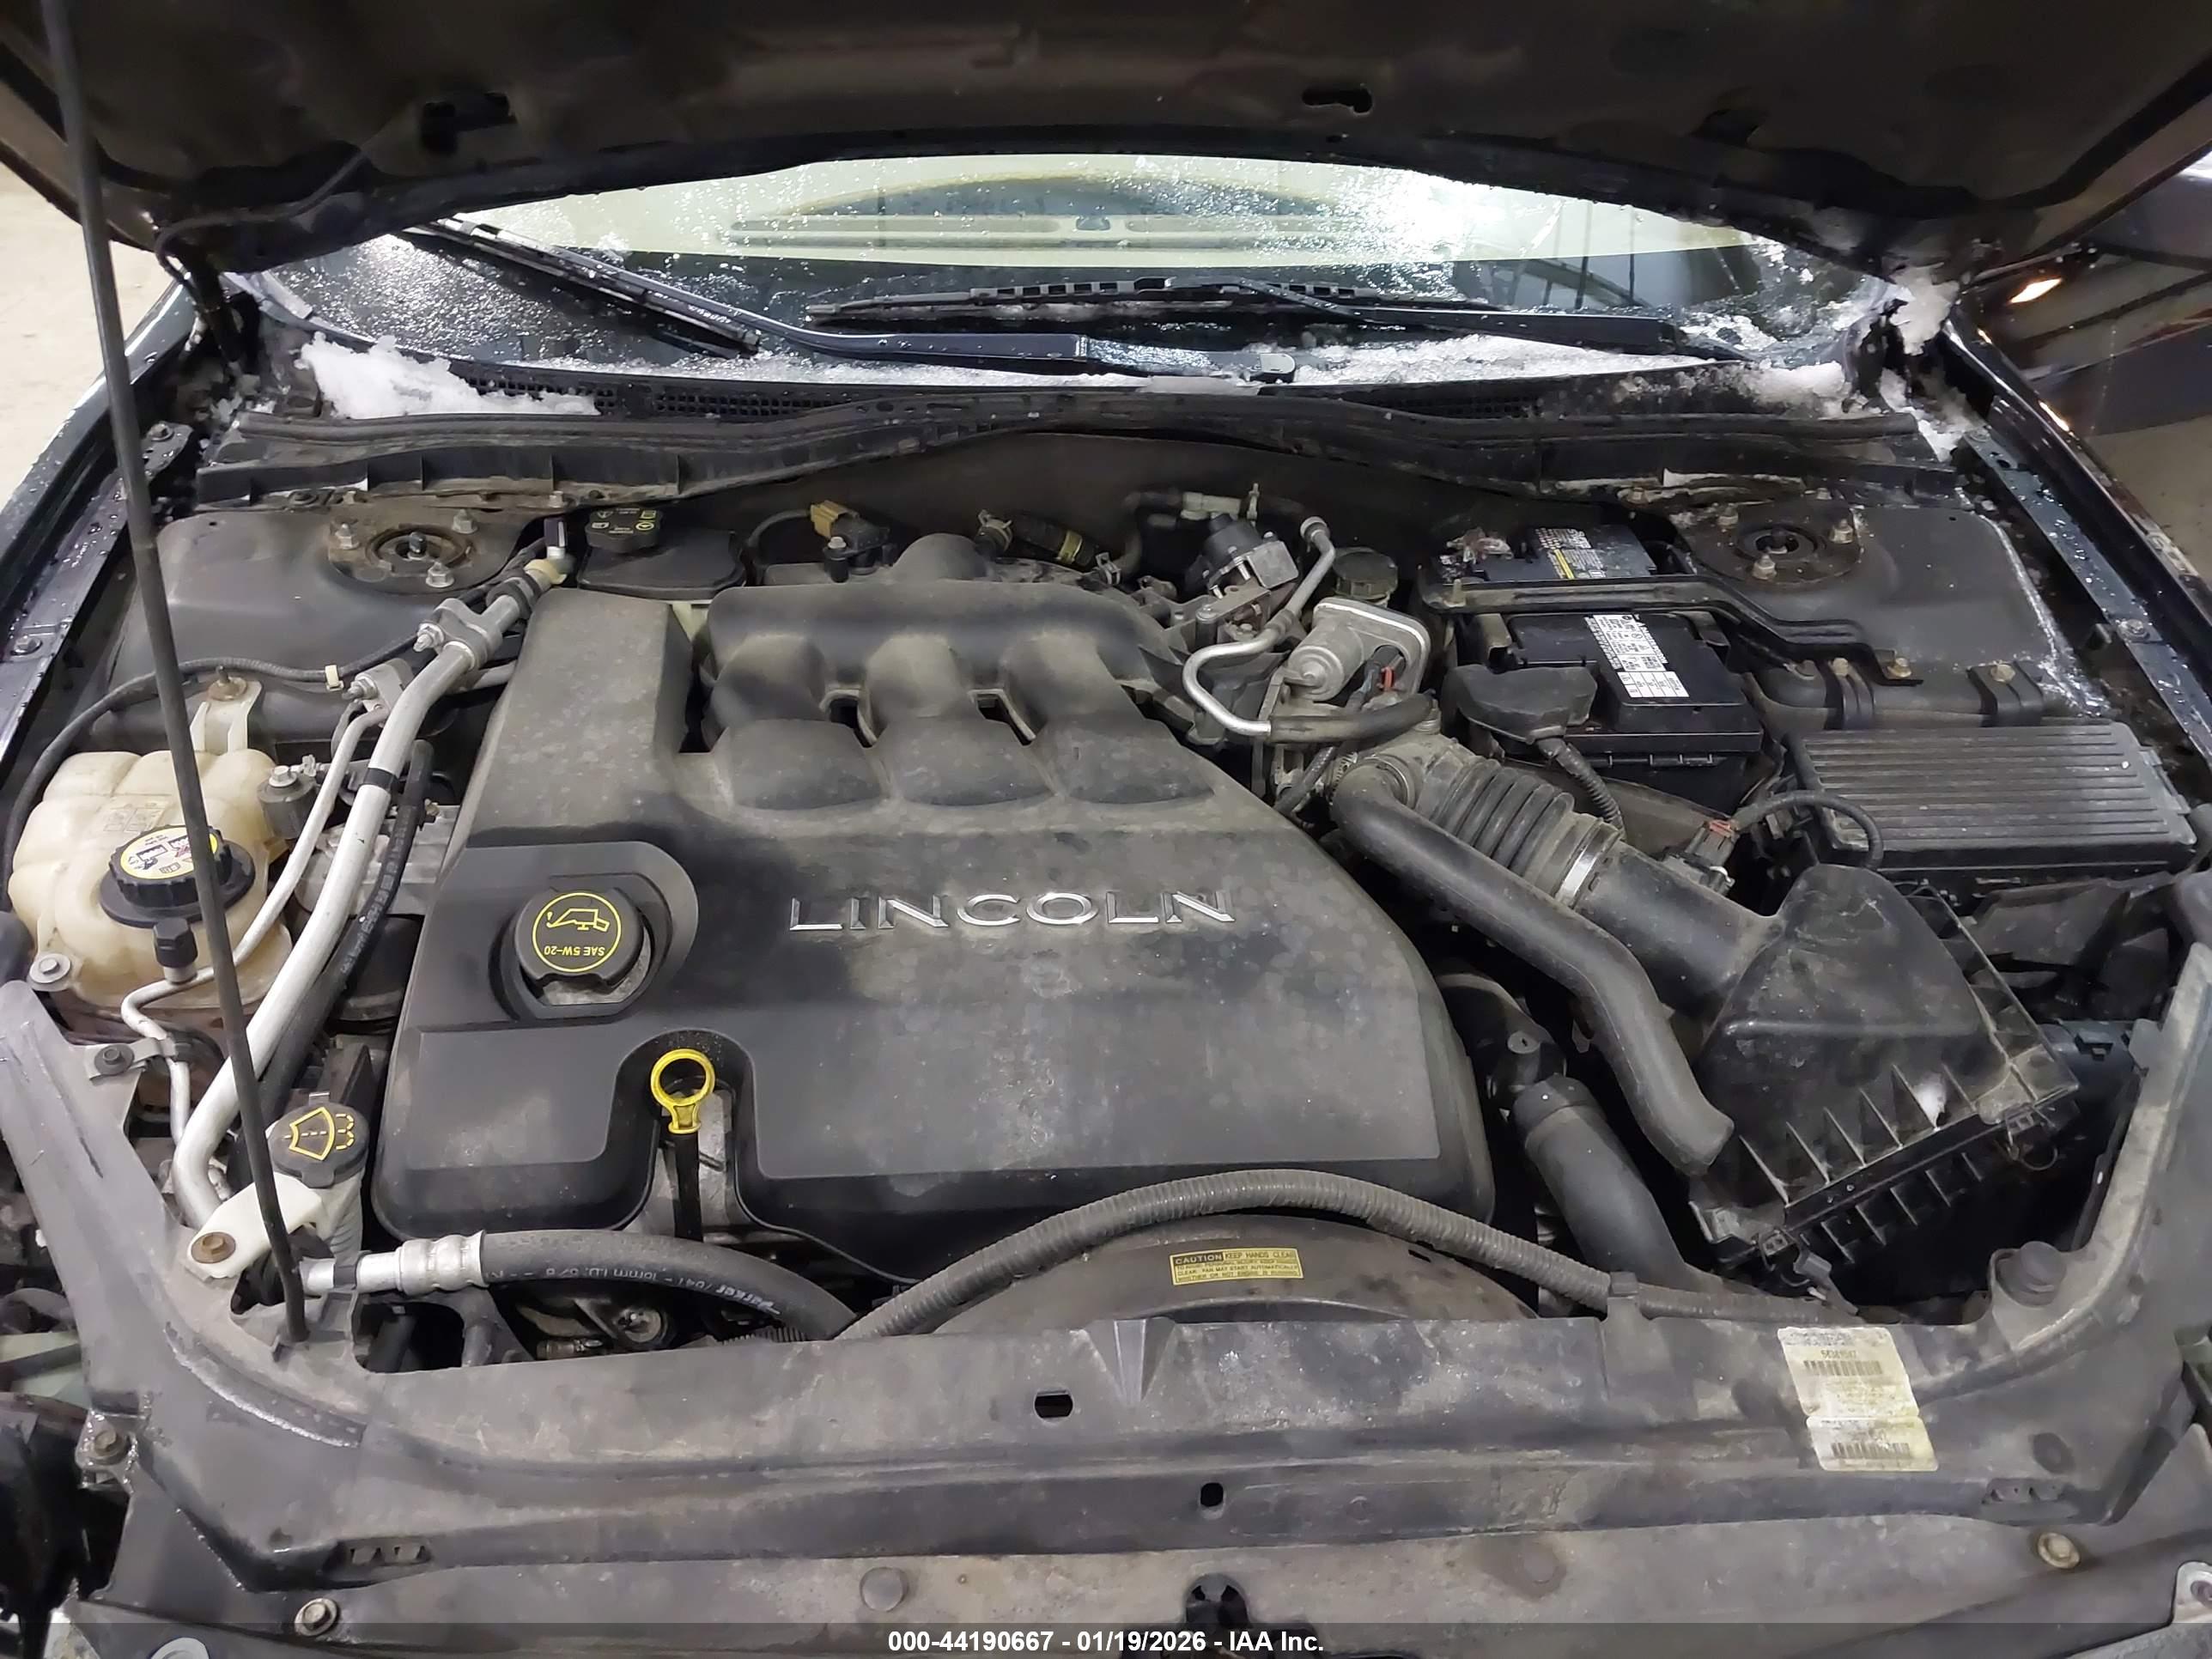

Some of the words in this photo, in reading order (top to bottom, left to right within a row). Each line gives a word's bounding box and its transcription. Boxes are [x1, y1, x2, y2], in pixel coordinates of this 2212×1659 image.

[789, 890, 1235, 931] LINCOLN
[544, 945, 580, 956] 5W-20
[583, 945, 605, 957] SAE
[1175, 1254, 1223, 1265] CAUTION
